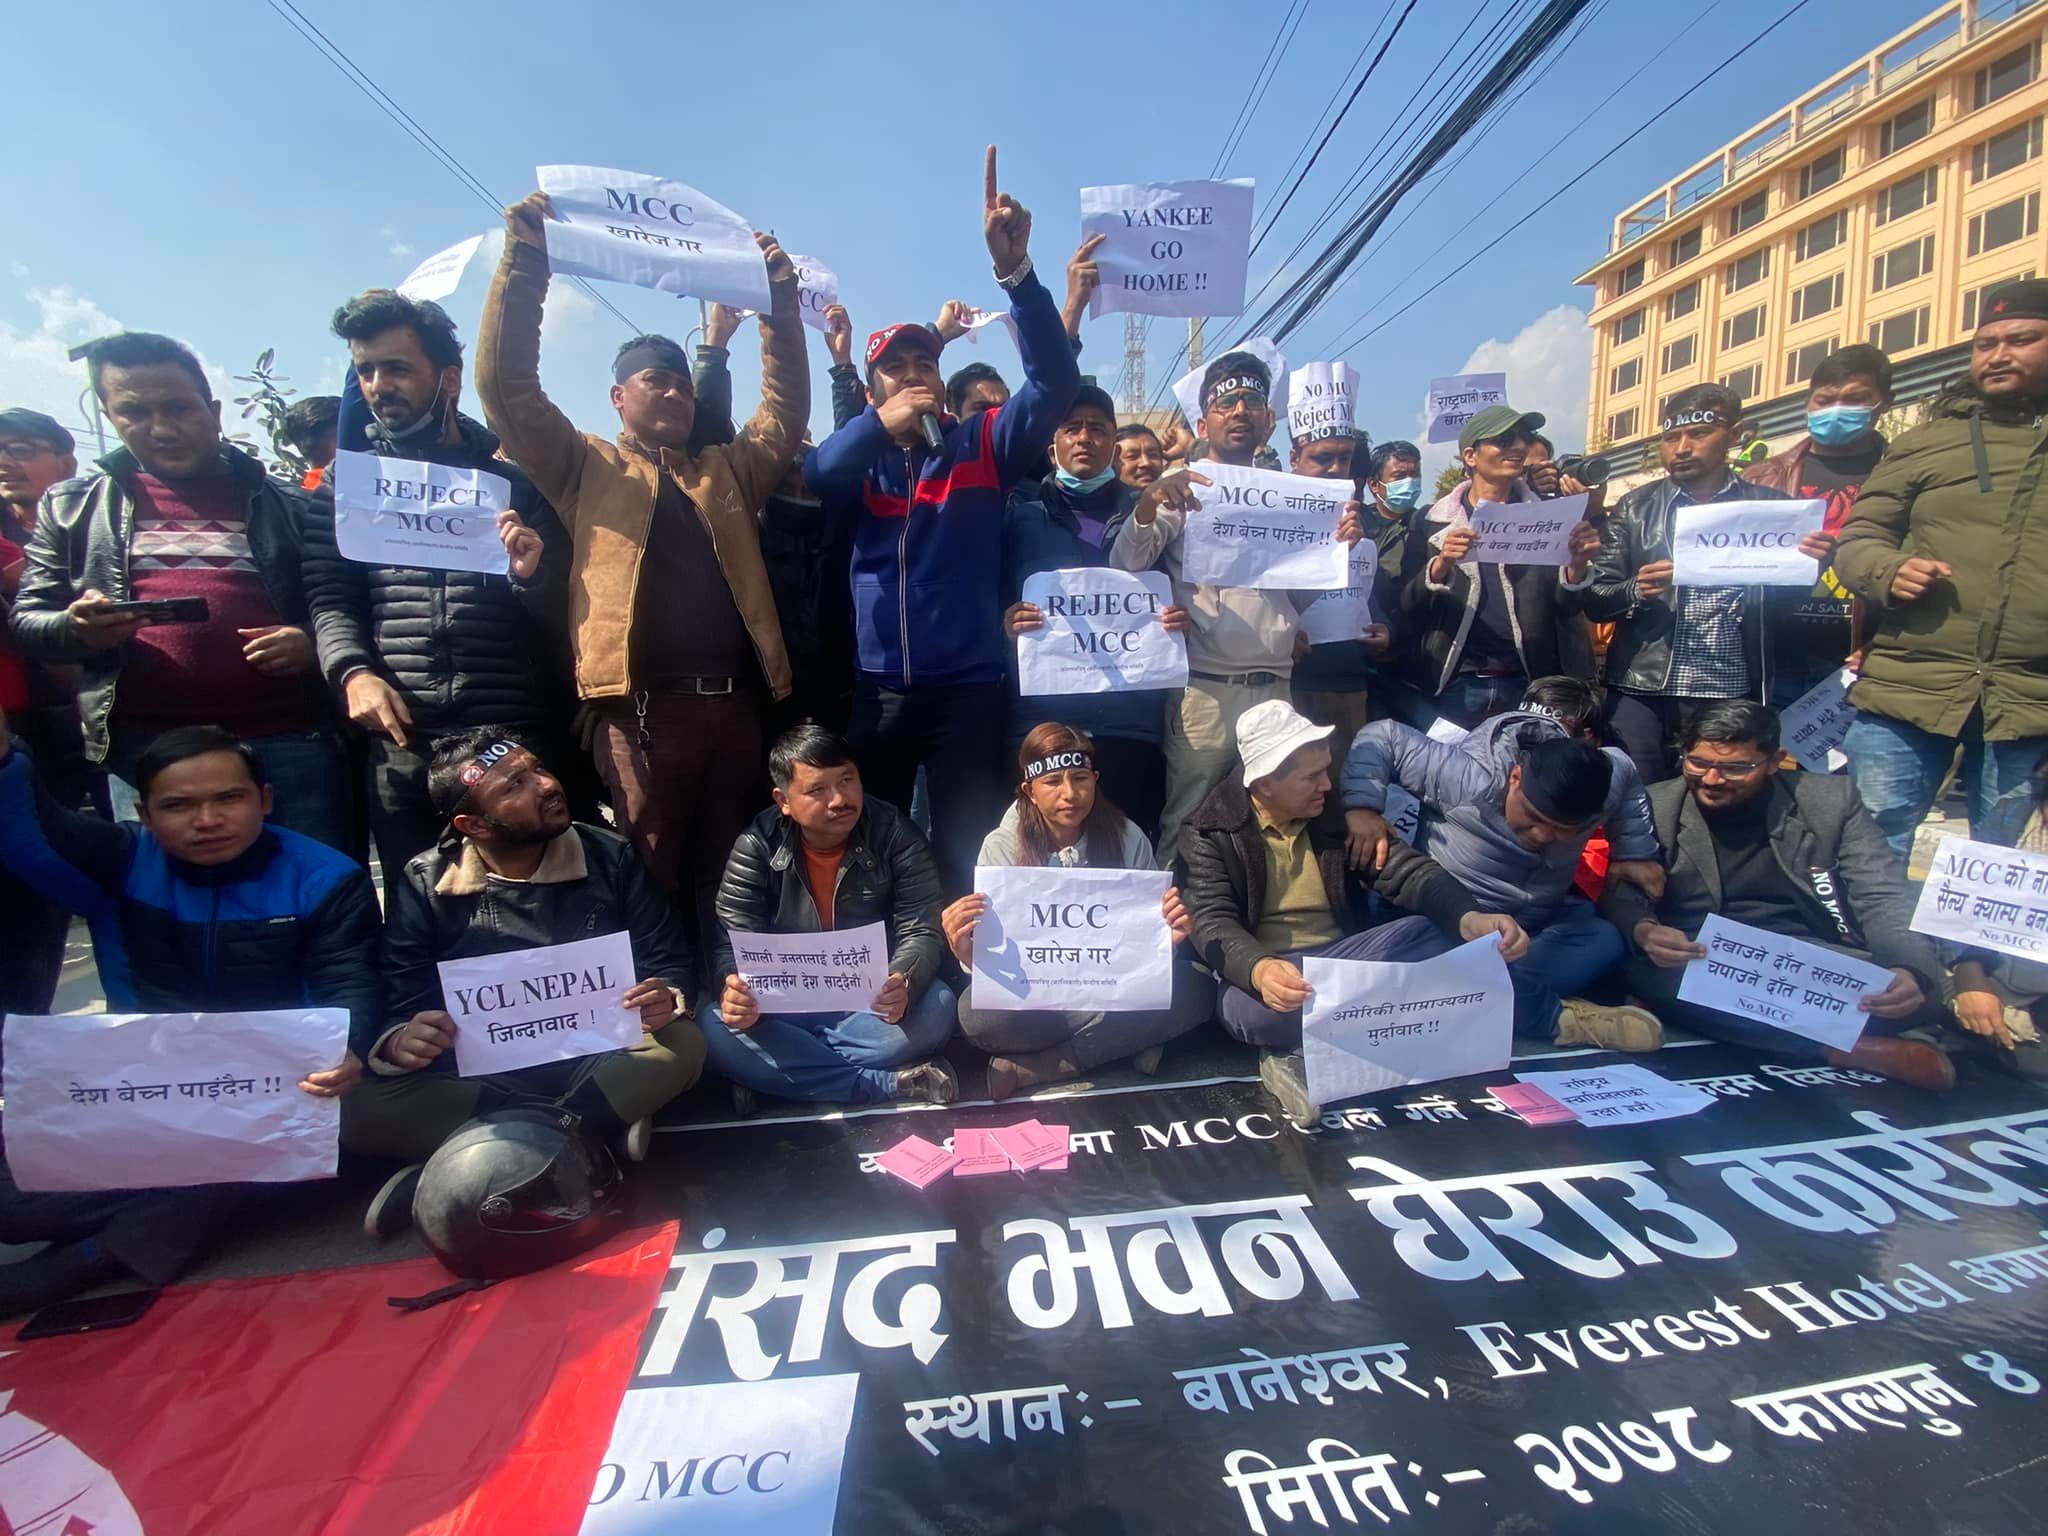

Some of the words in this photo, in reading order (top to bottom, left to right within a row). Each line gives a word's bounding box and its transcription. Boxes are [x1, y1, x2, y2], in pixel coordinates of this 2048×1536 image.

[607, 187, 694, 226] MCC
[1123, 206, 1213, 229] YANKEE
[607, 224, 670, 248] खारेज
[675, 239, 703, 255] गर
[1151, 240, 1183, 261] GO
[1123, 272, 1189, 292] HOME
[1194, 271, 1208, 291] !!
[799, 287, 825, 313] CC
[1215, 377, 1237, 397] NO
[1302, 382, 1322, 401] NO
[1293, 404, 1336, 431] Reject
[1663, 418, 1672, 431] O
[1675, 410, 1715, 427] MCC
[1311, 426, 1331, 442] NO
[374, 478, 487, 507] REJECT
[1218, 485, 1278, 509] MCC
[396, 511, 465, 536] MCC
[1213, 518, 1235, 538] देश
[1694, 533, 1731, 549] NO
[1736, 531, 1796, 549] MCC
[1047, 592, 1160, 619] REJECT
[1073, 631, 1141, 654] MCC
[1529, 702, 1563, 720] MCC
[480, 744, 509, 767] NO
[1027, 759, 1043, 777] NO
[1046, 752, 1083, 771] MCC
[1944, 853, 2001, 885] MCC
[2004, 859, 2030, 889] को
[2032, 869, 2048, 896] ना
[1030, 902, 1110, 929] MCC
[1812, 870, 1832, 896] NO
[1822, 898, 1849, 935] MCC
[1973, 896, 2023, 927] क्याम्प
[2025, 907, 2048, 933] बन
[1980, 928, 1999, 941] No
[2001, 933, 2042, 951] MCC
[740, 946, 774, 964] नेपाली
[1026, 940, 1082, 966] खारेज
[1087, 947, 1113, 966] गर
[1710, 932, 1769, 963] देखाउने
[1773, 952, 1803, 975] दाँत
[1811, 964, 1868, 993] सहयोग
[454, 984, 516, 1016] YCL
[522, 964, 616, 1006] NEPAL
[801, 971, 819, 992] देश
[1707, 959, 1763, 988] चपाउने
[1766, 975, 1799, 999] दाँत
[1801, 989, 1849, 1017] प्रयोग
[1332, 1002, 1394, 1023] अमेरिकी
[1399, 991, 1486, 1015] साम्राज्यवाद
[1735, 997, 1755, 1011] No
[1757, 1003, 1794, 1025] MCC
[487, 1011, 580, 1047] जिन्दावाद
[591, 1009, 597, 1025] !
[1367, 1021, 1426, 1047] मुर्दावाद
[69, 1081, 109, 1106] देश
[117, 1079, 171, 1103] बेच्न
[264, 1076, 282, 1094] !!
[1141, 1112, 1280, 1152] MCC
[1004, 1194, 1361, 1331] भवन
[1347, 1155, 1739, 1284] घेराउ
[1456, 1294, 1774, 1380] Everest
[1744, 1262, 1977, 1333] Hotel
[1949, 1230, 2048, 1294] अगा
[1514, 1406, 1734, 1505] २०७८
[1730, 1362, 1979, 1438] फाल्गुन
[1961, 1350, 2041, 1395] ४
[588, 1462, 627, 1505] O
[634, 1449, 792, 1502] MCC
